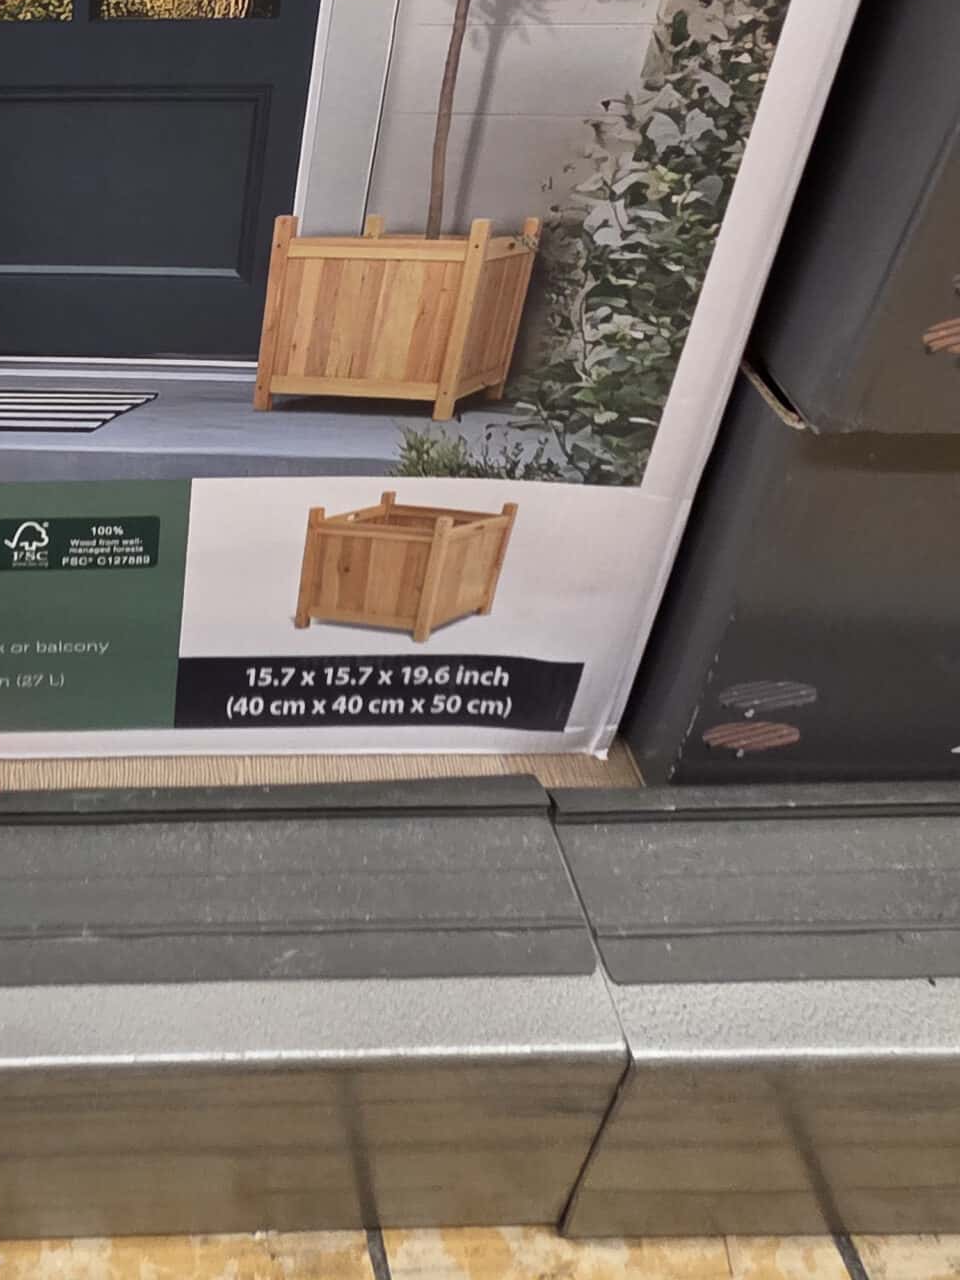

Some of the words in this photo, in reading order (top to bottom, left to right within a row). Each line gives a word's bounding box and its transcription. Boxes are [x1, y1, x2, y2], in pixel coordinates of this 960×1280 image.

[91, 525, 124, 536] 100%
[10, 644, 30, 655] or
[35, 639, 110, 656] balcony
[48, 672, 66, 688] L)
[245, 666, 296, 688] 15.7
[300, 671, 316, 687] x
[323, 666, 373, 688] 15.7
[377, 671, 393, 687] x
[400, 666, 450, 687] 19.6
[455, 665, 509, 688] inch
[225, 696, 265, 719] (40
[269, 699, 306, 716] cm
[310, 699, 326, 716] x
[332, 696, 363, 716] 40
[368, 699, 406, 716] cm
[410, 700, 426, 716] x
[430, 695, 463, 715] 50
[466, 695, 513, 719] cm)
